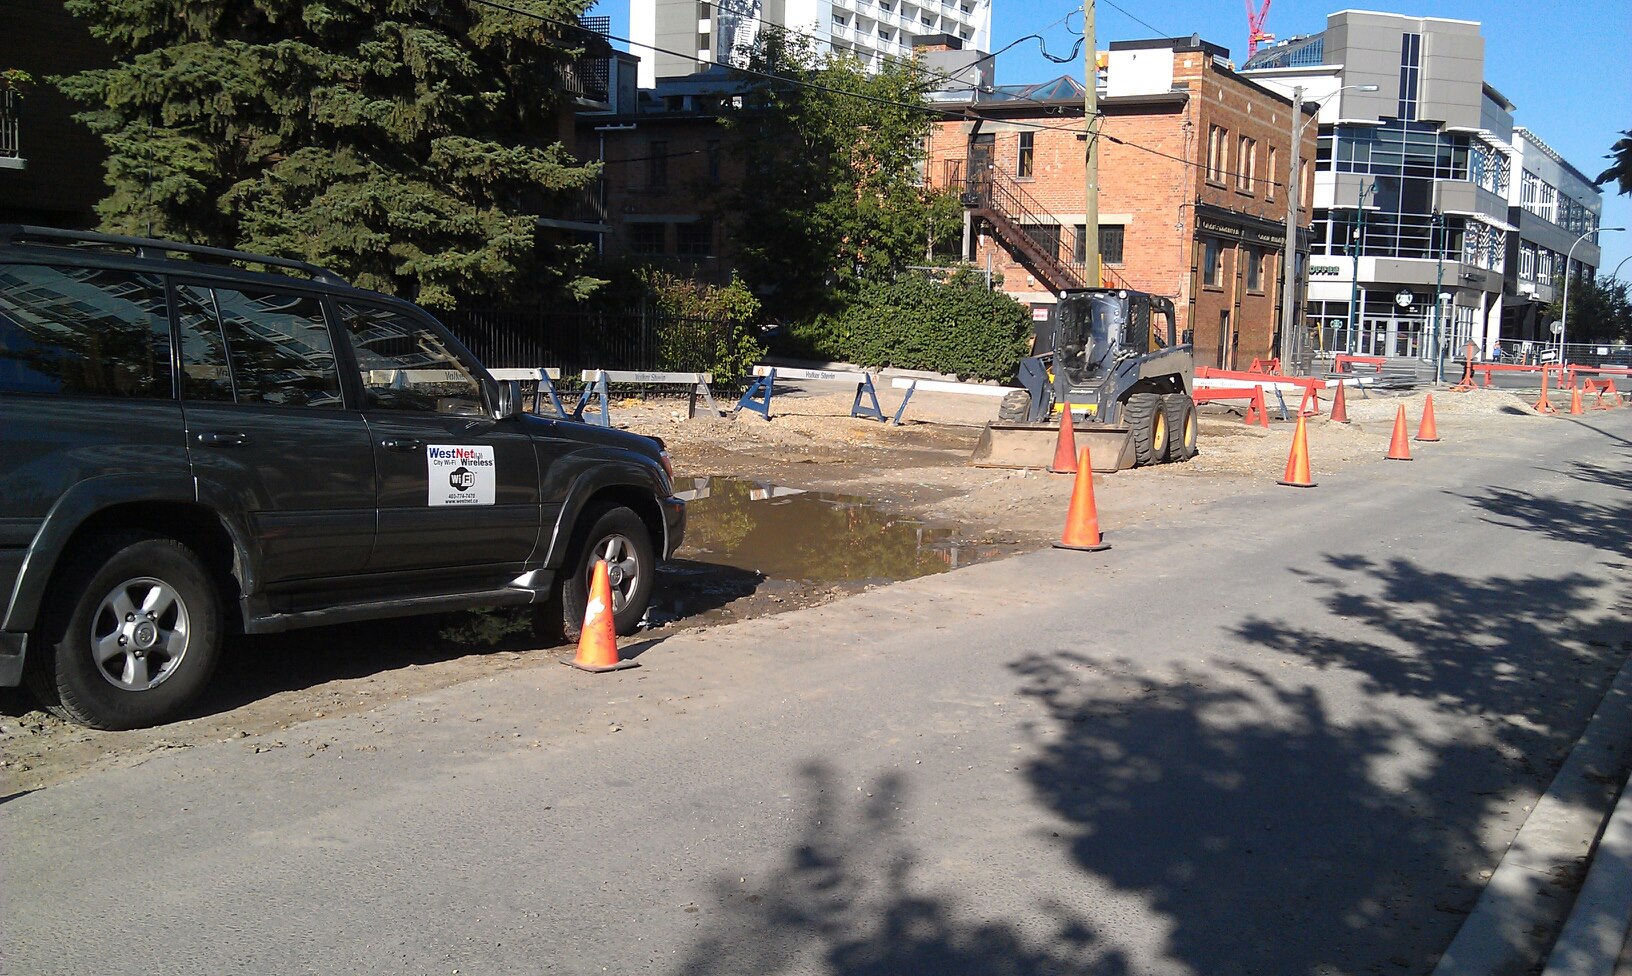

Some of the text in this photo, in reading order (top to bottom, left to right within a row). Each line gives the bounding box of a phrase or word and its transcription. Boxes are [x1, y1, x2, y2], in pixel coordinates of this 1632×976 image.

[1309, 265, 1340, 276] OFFEE
[429, 447, 474, 459] WestNet
[460, 456, 493, 466] Wireless
